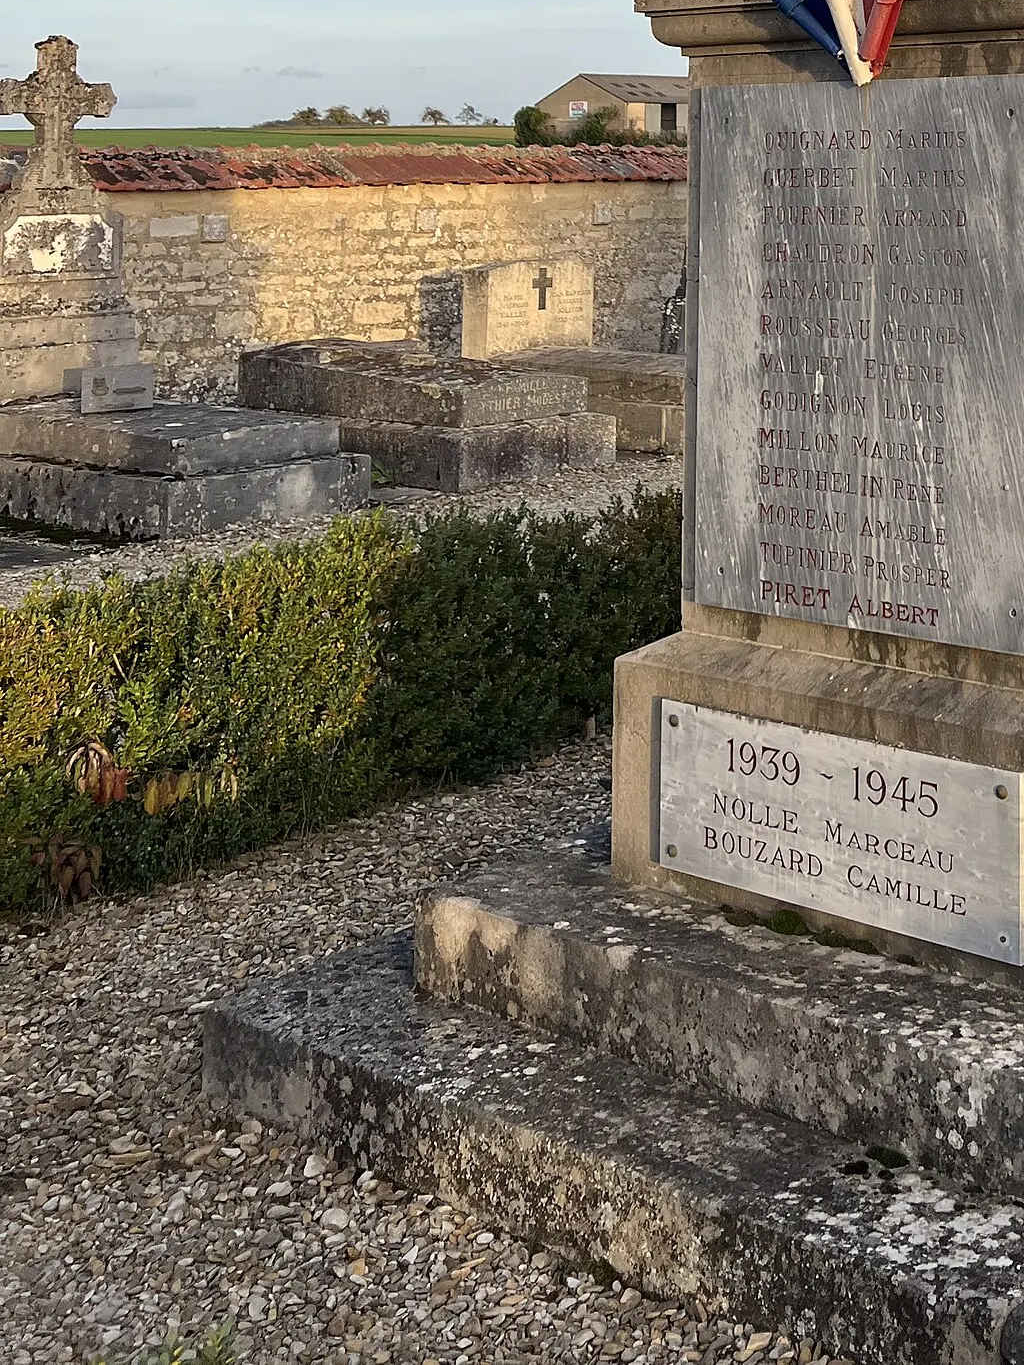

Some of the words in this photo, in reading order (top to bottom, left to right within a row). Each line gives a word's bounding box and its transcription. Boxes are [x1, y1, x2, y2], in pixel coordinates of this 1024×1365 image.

[765, 129, 872, 154] QUIGNARD
[886, 129, 966, 150] MARIUS
[763, 167, 858, 189] GUERBET
[880, 167, 966, 188] MARIUS
[762, 205, 865, 226] FOURNIER
[879, 208, 967, 228] ARMAND
[762, 242, 875, 265] CHAUDRON
[887, 243, 968, 267] GASTON
[761, 279, 864, 302] ARNAULT
[884, 282, 964, 306] JOSEPH
[760, 315, 871, 341] ROUSSEAU
[883, 320, 966, 345] GEORGES
[760, 353, 843, 376] VALLET
[760, 389, 867, 418] GODIGNON
[884, 397, 944, 424] LOUIS
[758, 427, 839, 453] MILLON
[852, 436, 945, 465] MAURICE
[759, 464, 883, 498] BERTHELIN
[758, 502, 847, 533] MOREAU
[860, 516, 946, 545] AMABLE
[760, 541, 854, 575] TUPINIER
[863, 555, 952, 589] PROSPER
[759, 579, 831, 610] PIRET
[848, 594, 939, 627] ALBERT
[726, 738, 801, 786] 1939
[851, 766, 939, 818] 1945
[712, 793, 799, 834] NOLLE
[823, 820, 954, 873] MARCEAU
[703, 826, 823, 877] BOUZARD
[847, 865, 968, 917] CAMILLE
